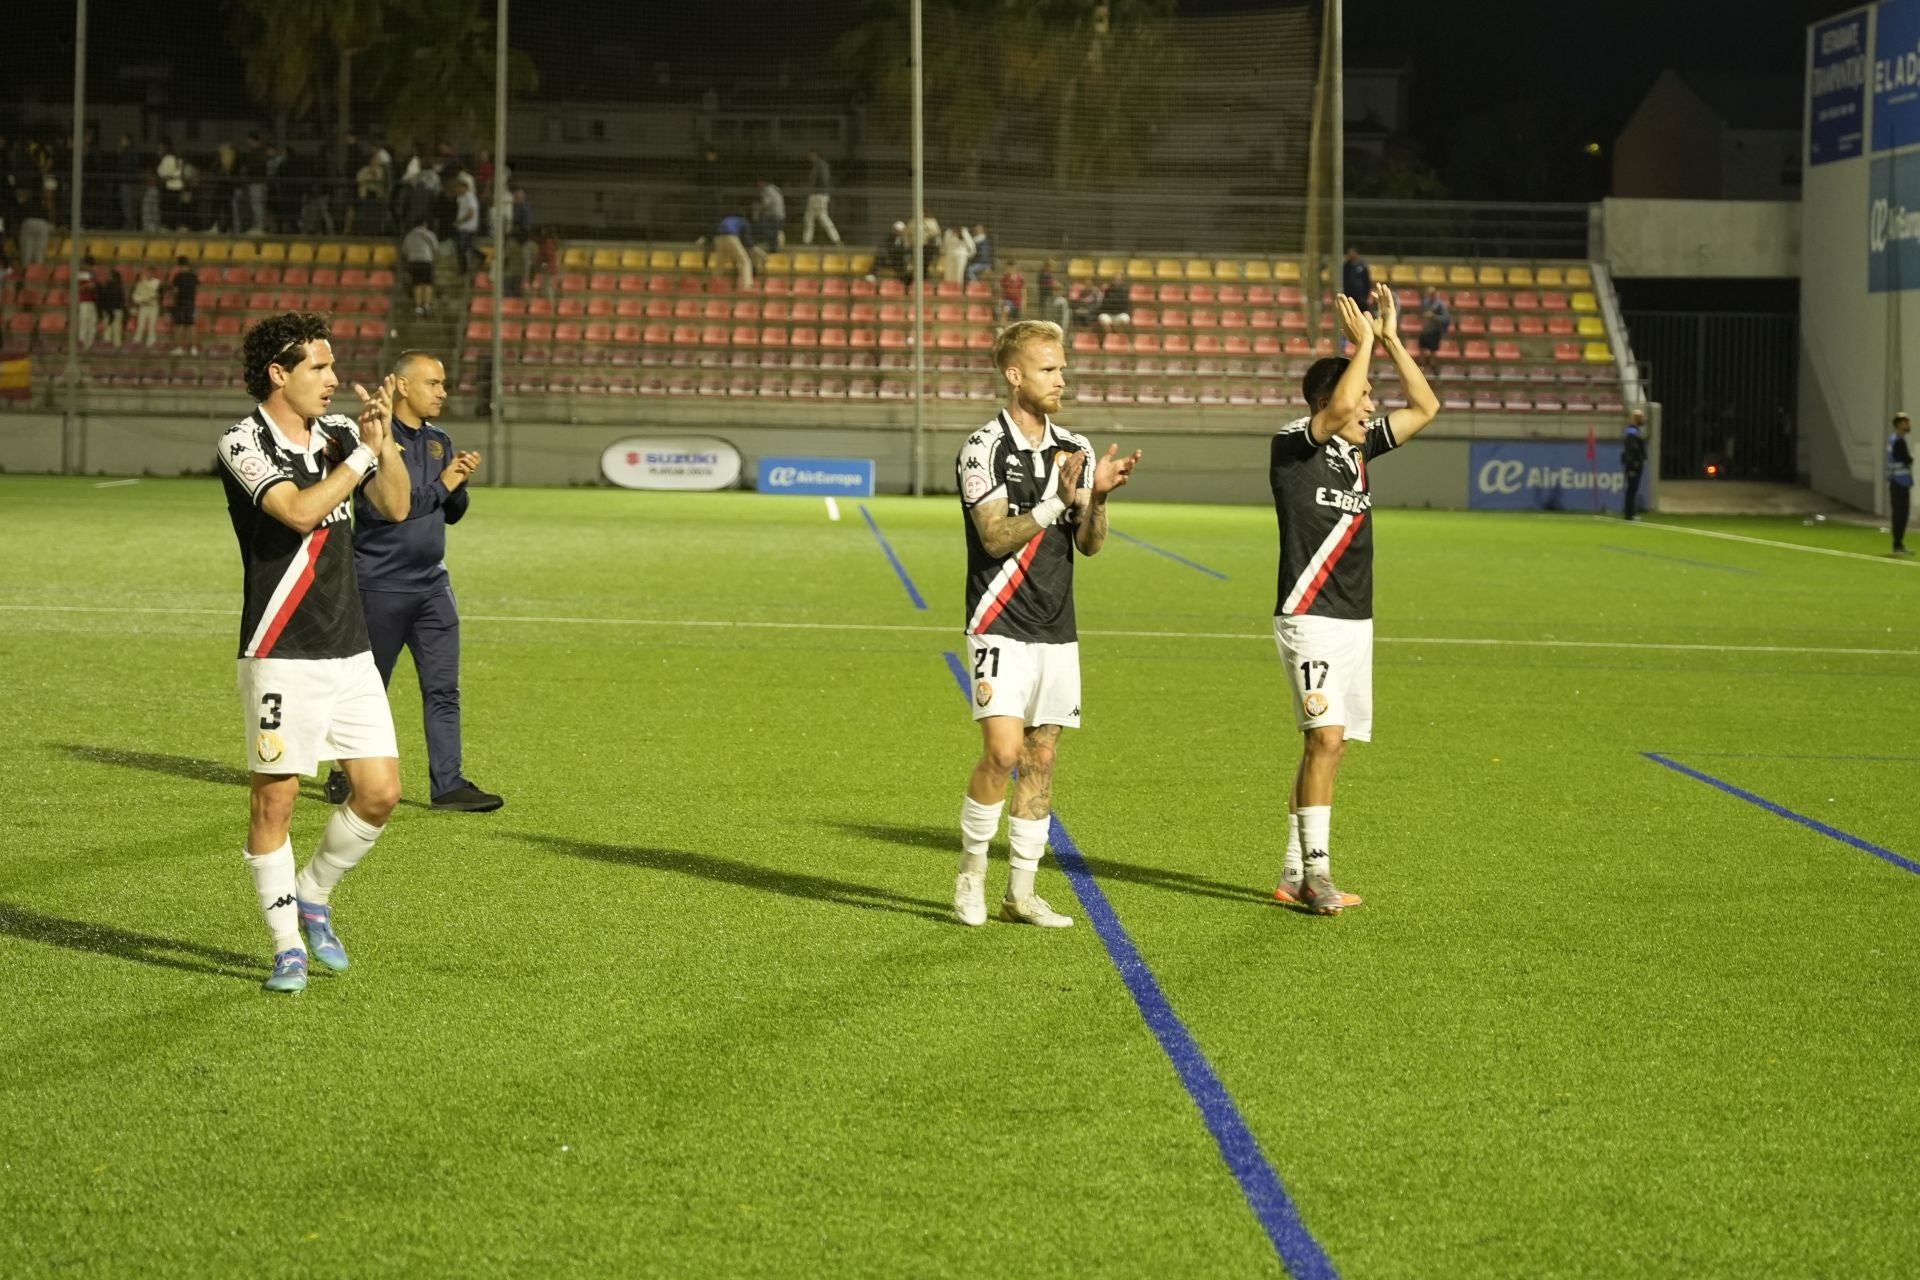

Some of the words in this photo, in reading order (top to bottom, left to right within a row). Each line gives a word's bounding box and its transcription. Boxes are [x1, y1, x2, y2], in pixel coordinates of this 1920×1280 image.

[1875, 52, 1920, 92] ELAD
[646, 453, 718, 464] SUZUKI
[797, 470, 863, 487] AirEuropa
[1527, 466, 1626, 493] AirEurop
[975, 646, 1000, 680] 21
[1300, 660, 1329, 691] 17
[260, 692, 282, 730] 3
